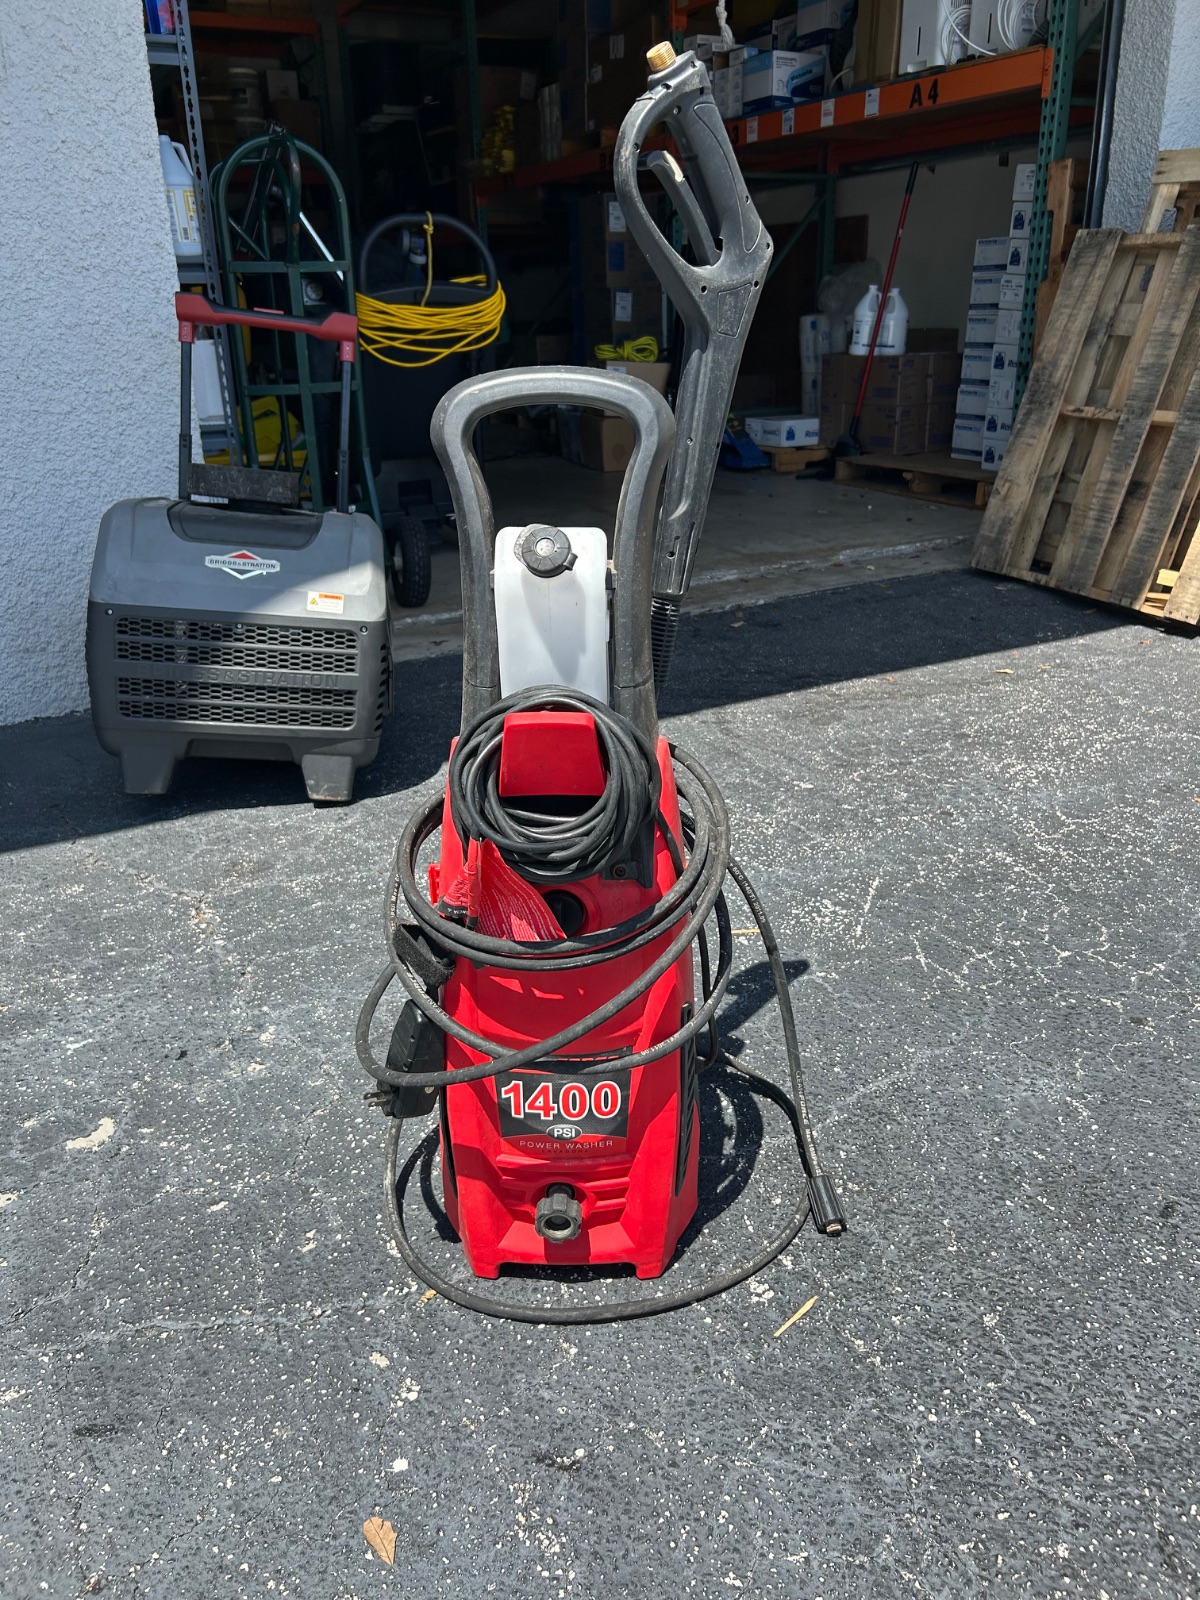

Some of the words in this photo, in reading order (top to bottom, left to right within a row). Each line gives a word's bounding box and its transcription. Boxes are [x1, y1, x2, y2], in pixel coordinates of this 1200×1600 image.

[501, 1080, 621, 1121] 1400
[554, 1127, 576, 1138] PSI
[520, 1141, 560, 1149] POWER
[565, 1140, 613, 1149] WASHER
